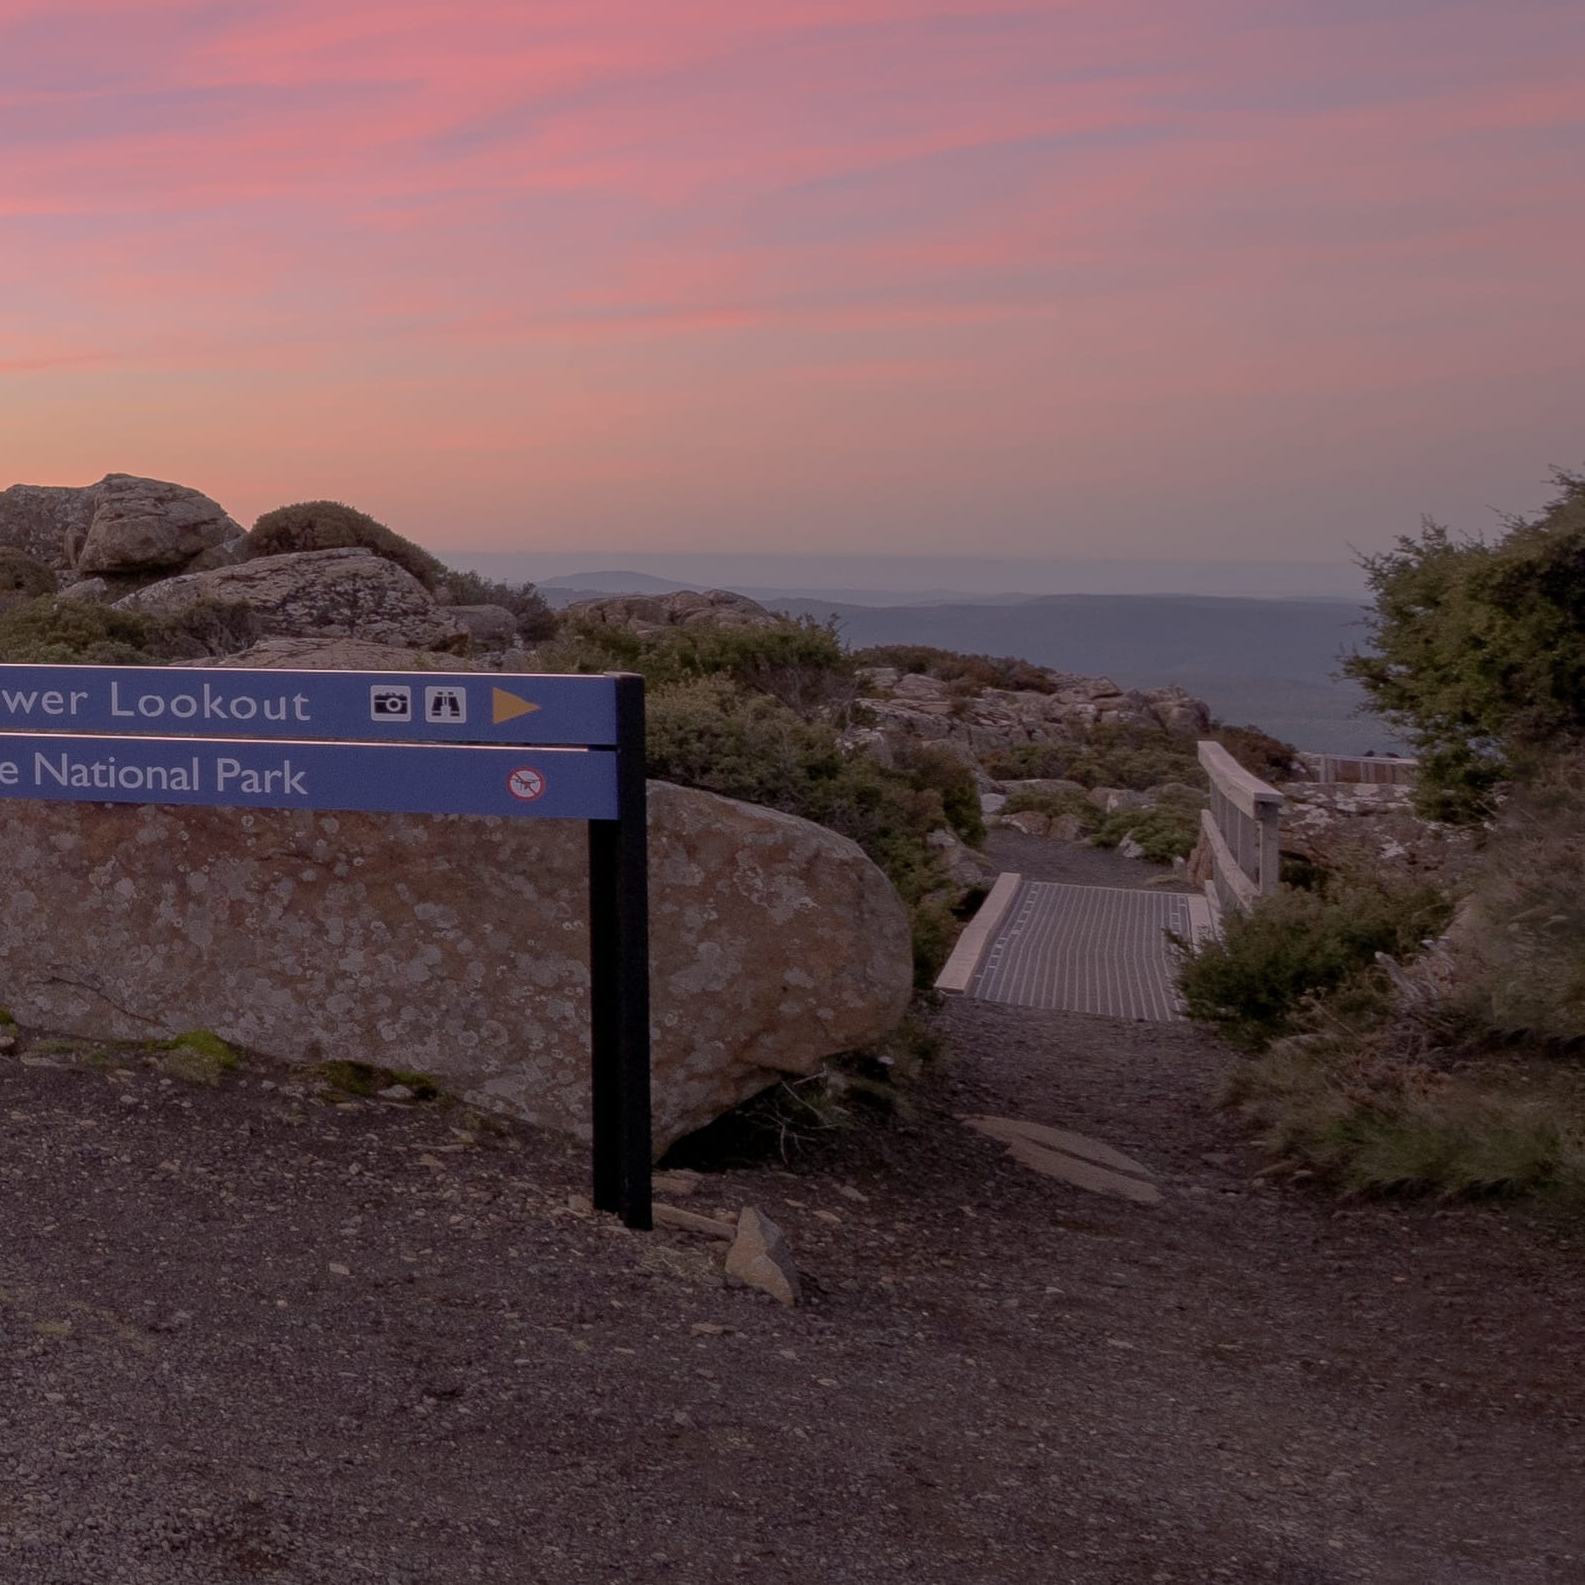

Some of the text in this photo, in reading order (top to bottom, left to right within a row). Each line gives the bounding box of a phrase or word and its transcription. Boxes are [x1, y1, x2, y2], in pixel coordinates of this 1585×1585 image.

[110, 681, 311, 721] Lookout
[34, 752, 199, 791] National
[216, 758, 308, 794] Park
